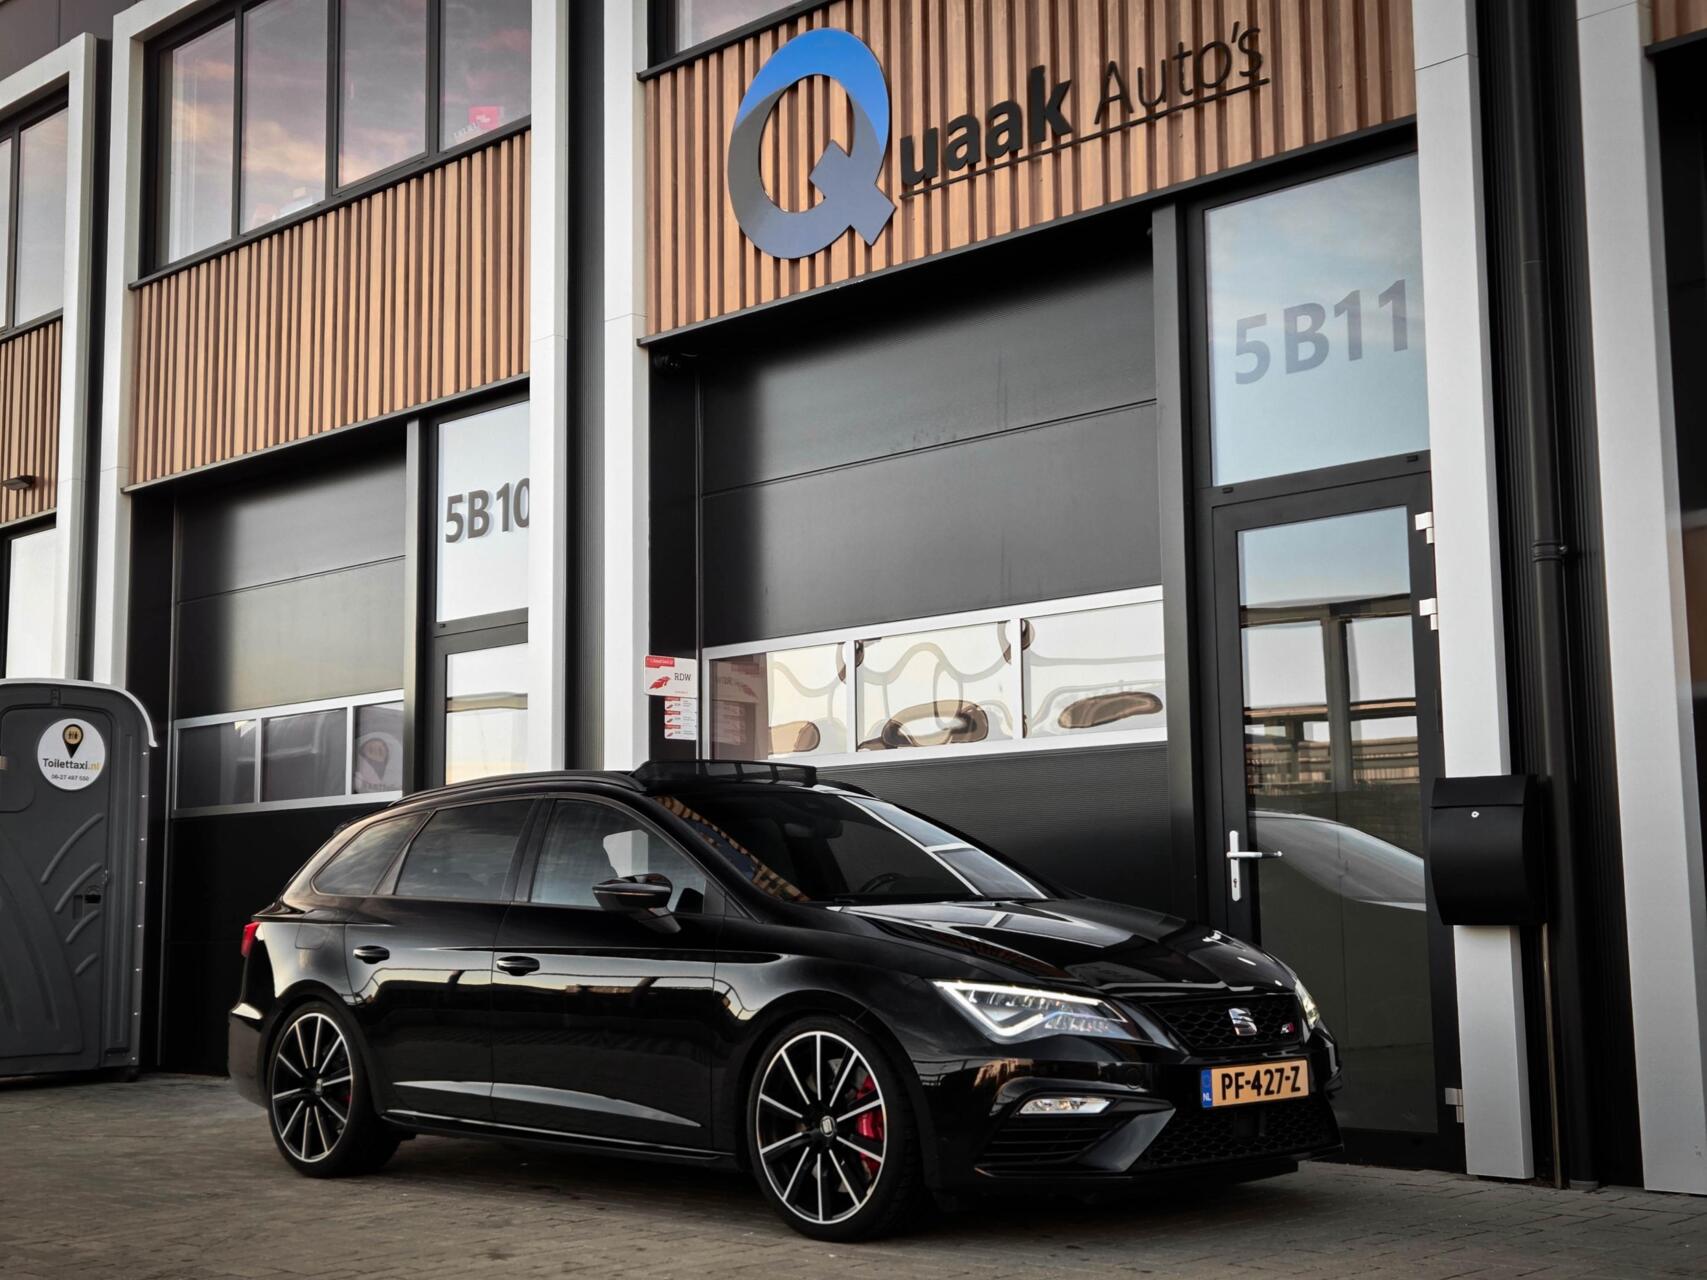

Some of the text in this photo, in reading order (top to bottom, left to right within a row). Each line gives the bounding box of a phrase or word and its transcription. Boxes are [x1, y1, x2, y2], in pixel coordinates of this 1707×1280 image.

[1095, 21, 1263, 125] Auto's
[1235, 279, 1408, 385] 5B11
[445, 477, 530, 543] 5B10
[674, 672, 692, 681] RDW
[43, 758, 100, 770] Toilettaxi.nl
[1202, 1065, 1301, 1101] NL PF-427-Z
